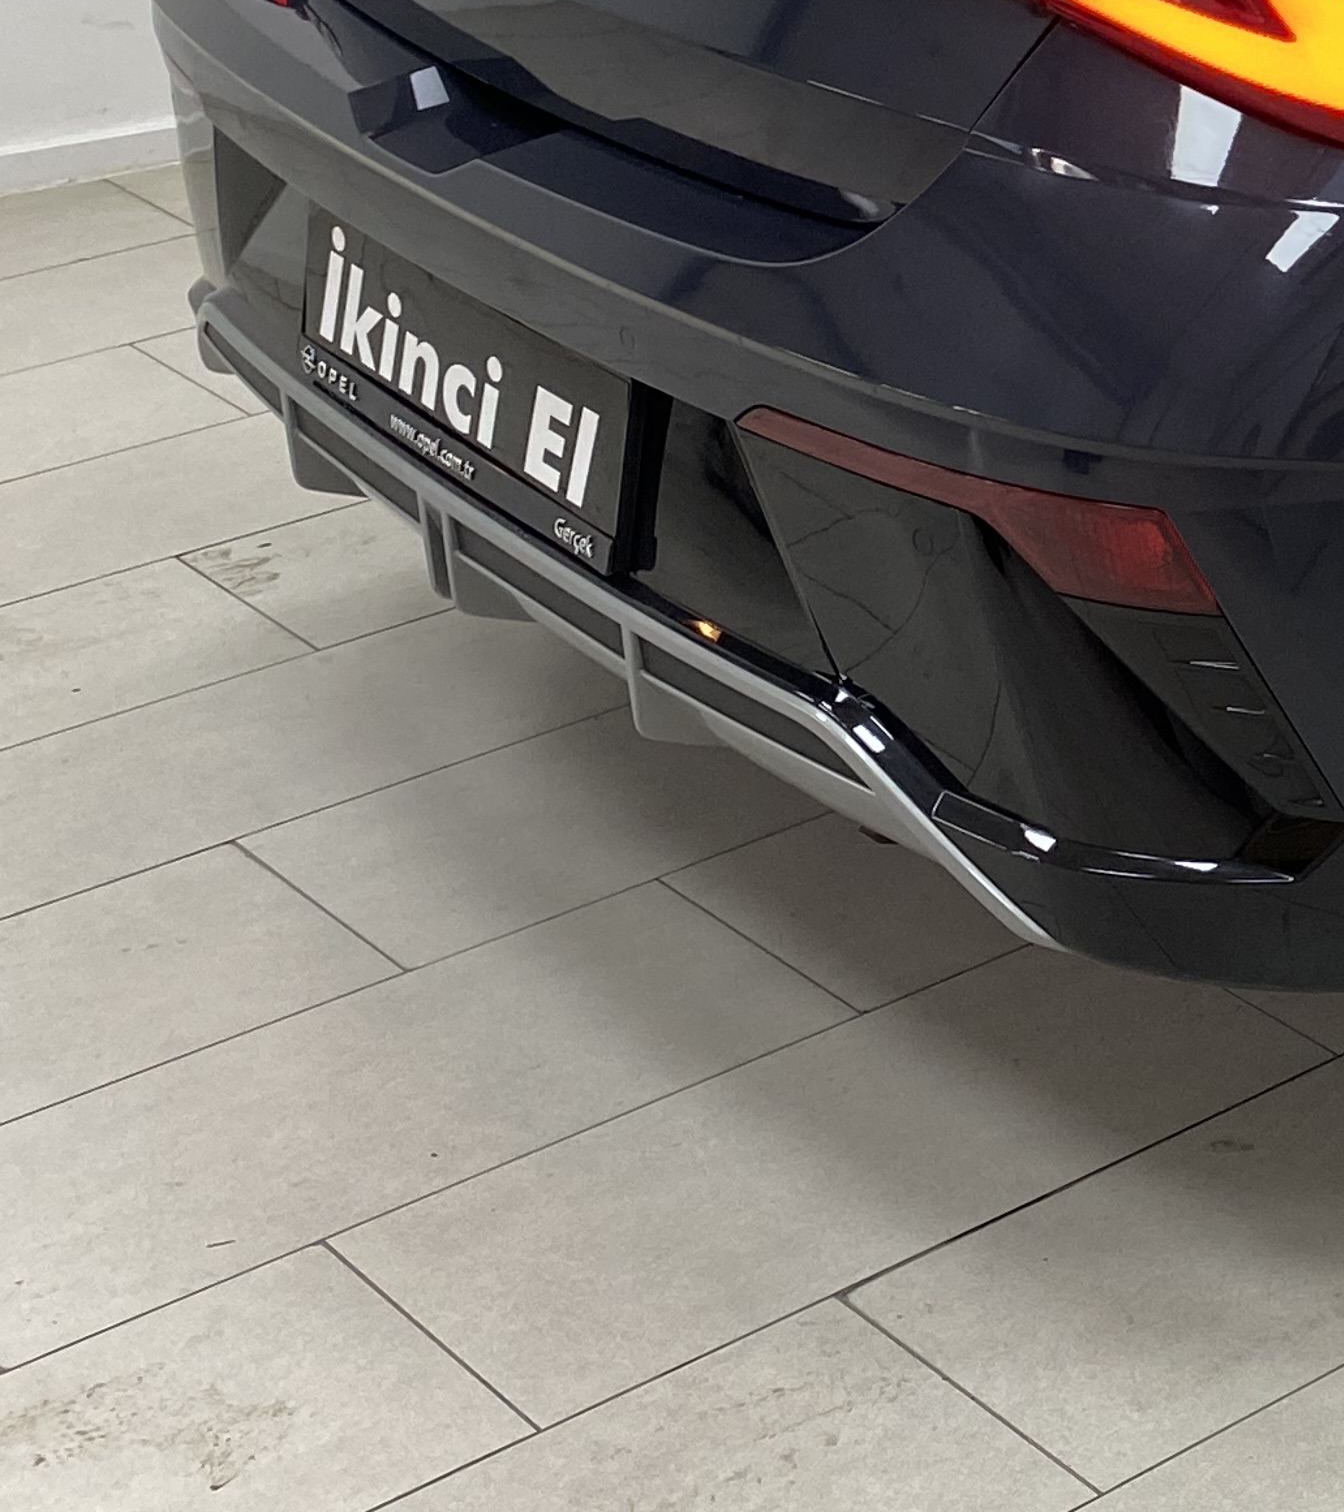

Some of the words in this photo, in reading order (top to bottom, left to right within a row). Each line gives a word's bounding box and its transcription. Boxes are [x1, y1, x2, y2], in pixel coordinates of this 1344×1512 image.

[317, 360, 357, 401] OPEL
[319, 225, 504, 451] İkinci
[523, 385, 600, 509] El
[390, 414, 476, 481] www.opel.com.tr
[553, 517, 593, 558] Gerçek
